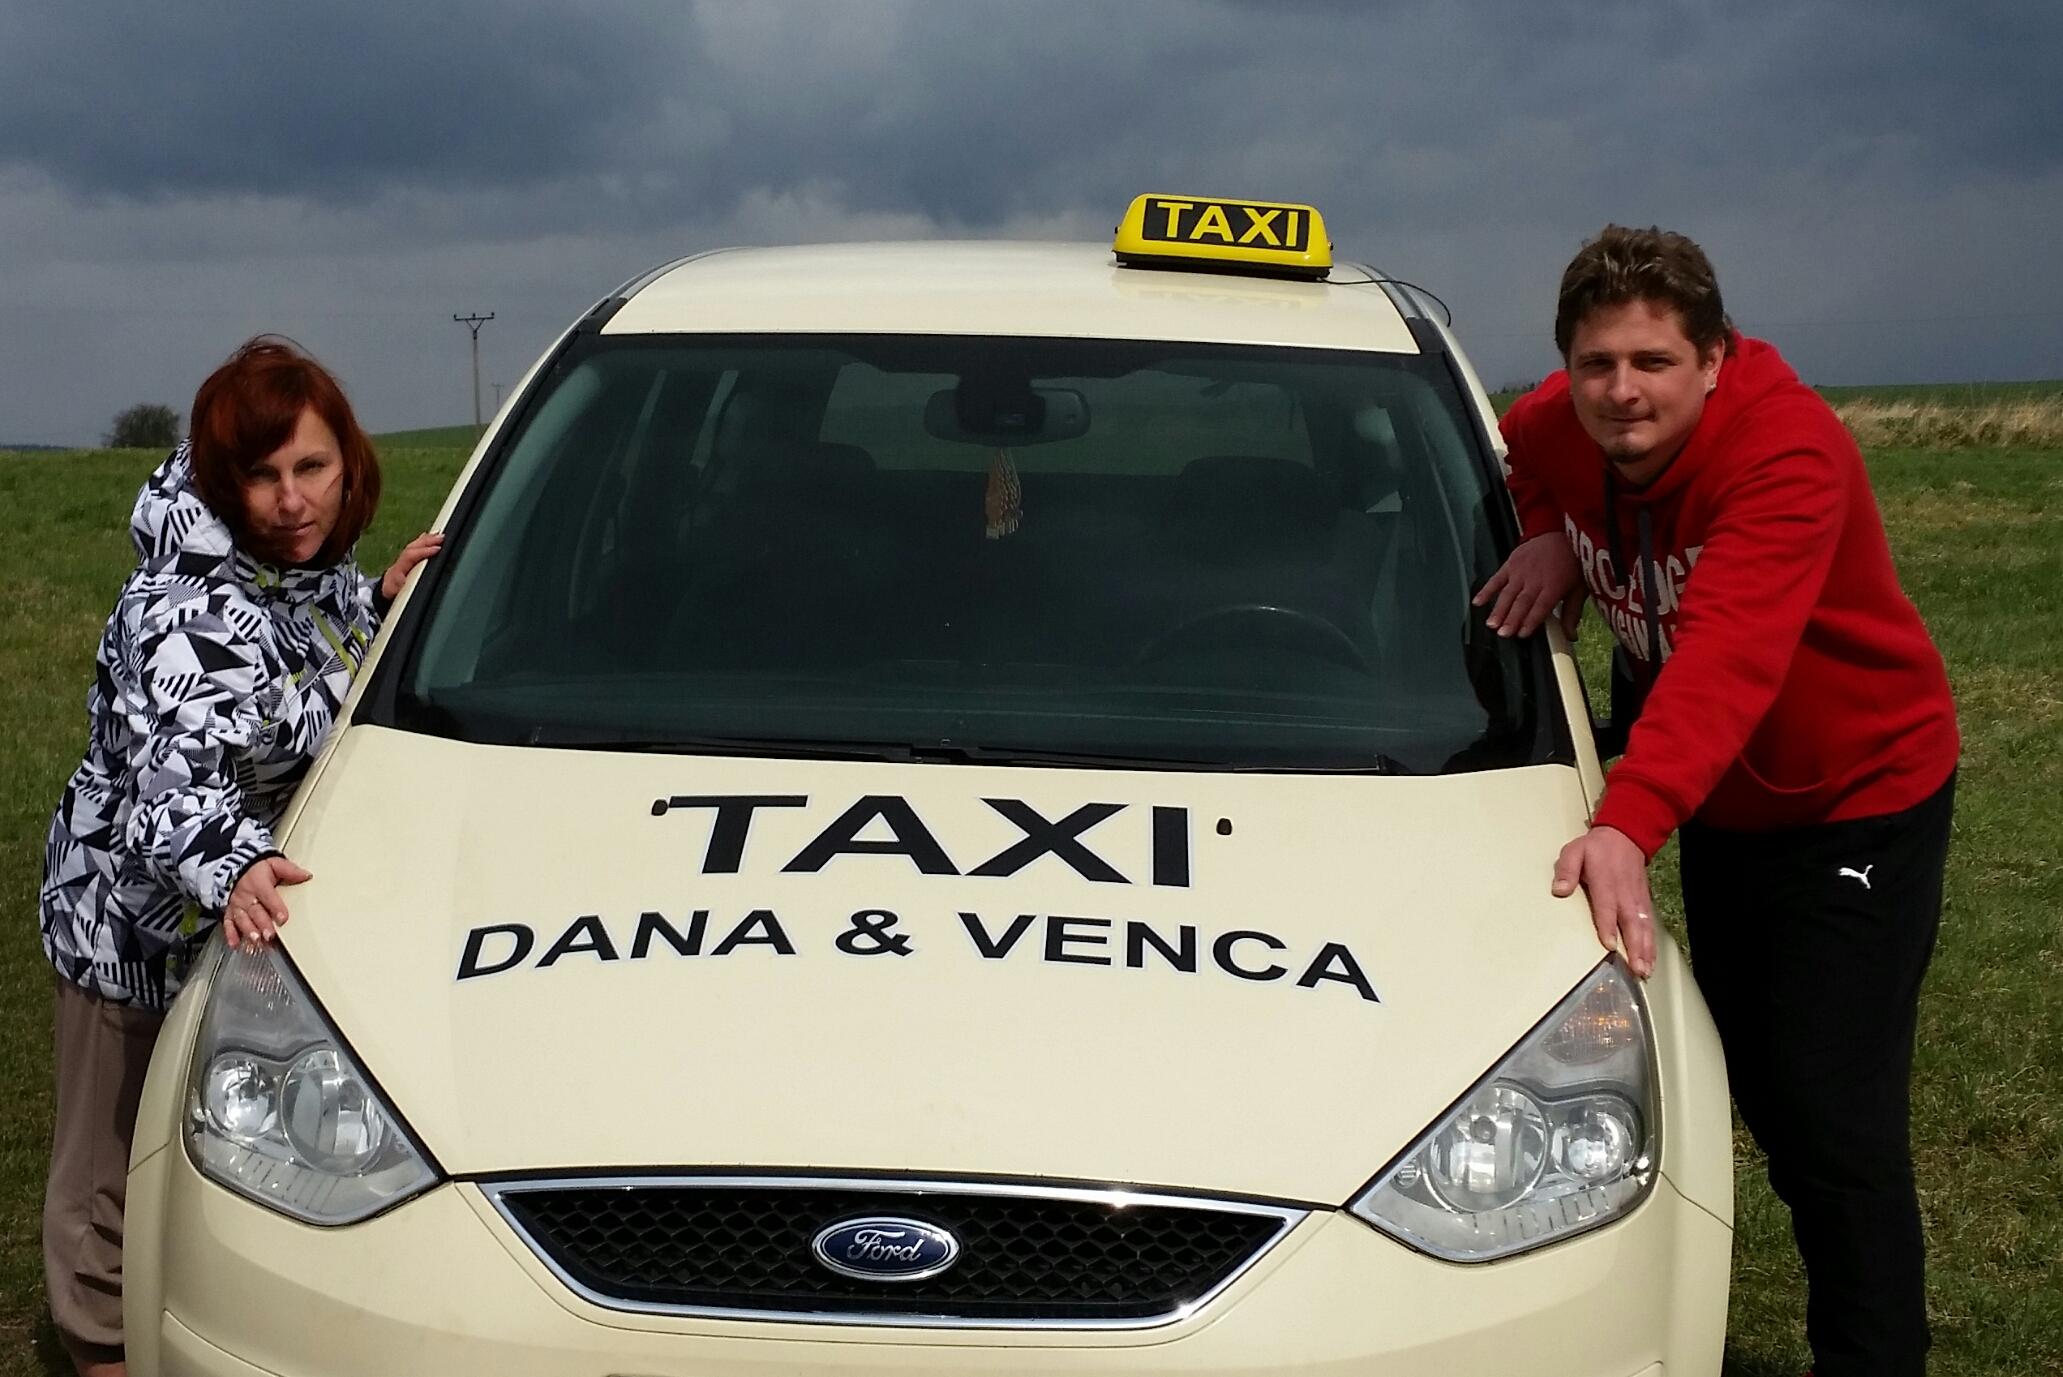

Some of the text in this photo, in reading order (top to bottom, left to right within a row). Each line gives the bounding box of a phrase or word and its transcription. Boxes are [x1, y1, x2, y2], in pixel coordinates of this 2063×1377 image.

[1156, 201, 1300, 248] TAXI
[666, 794, 1191, 888] TAXI
[456, 909, 1381, 1004] DANA & VENCA
[847, 1229, 925, 1262] Ford
